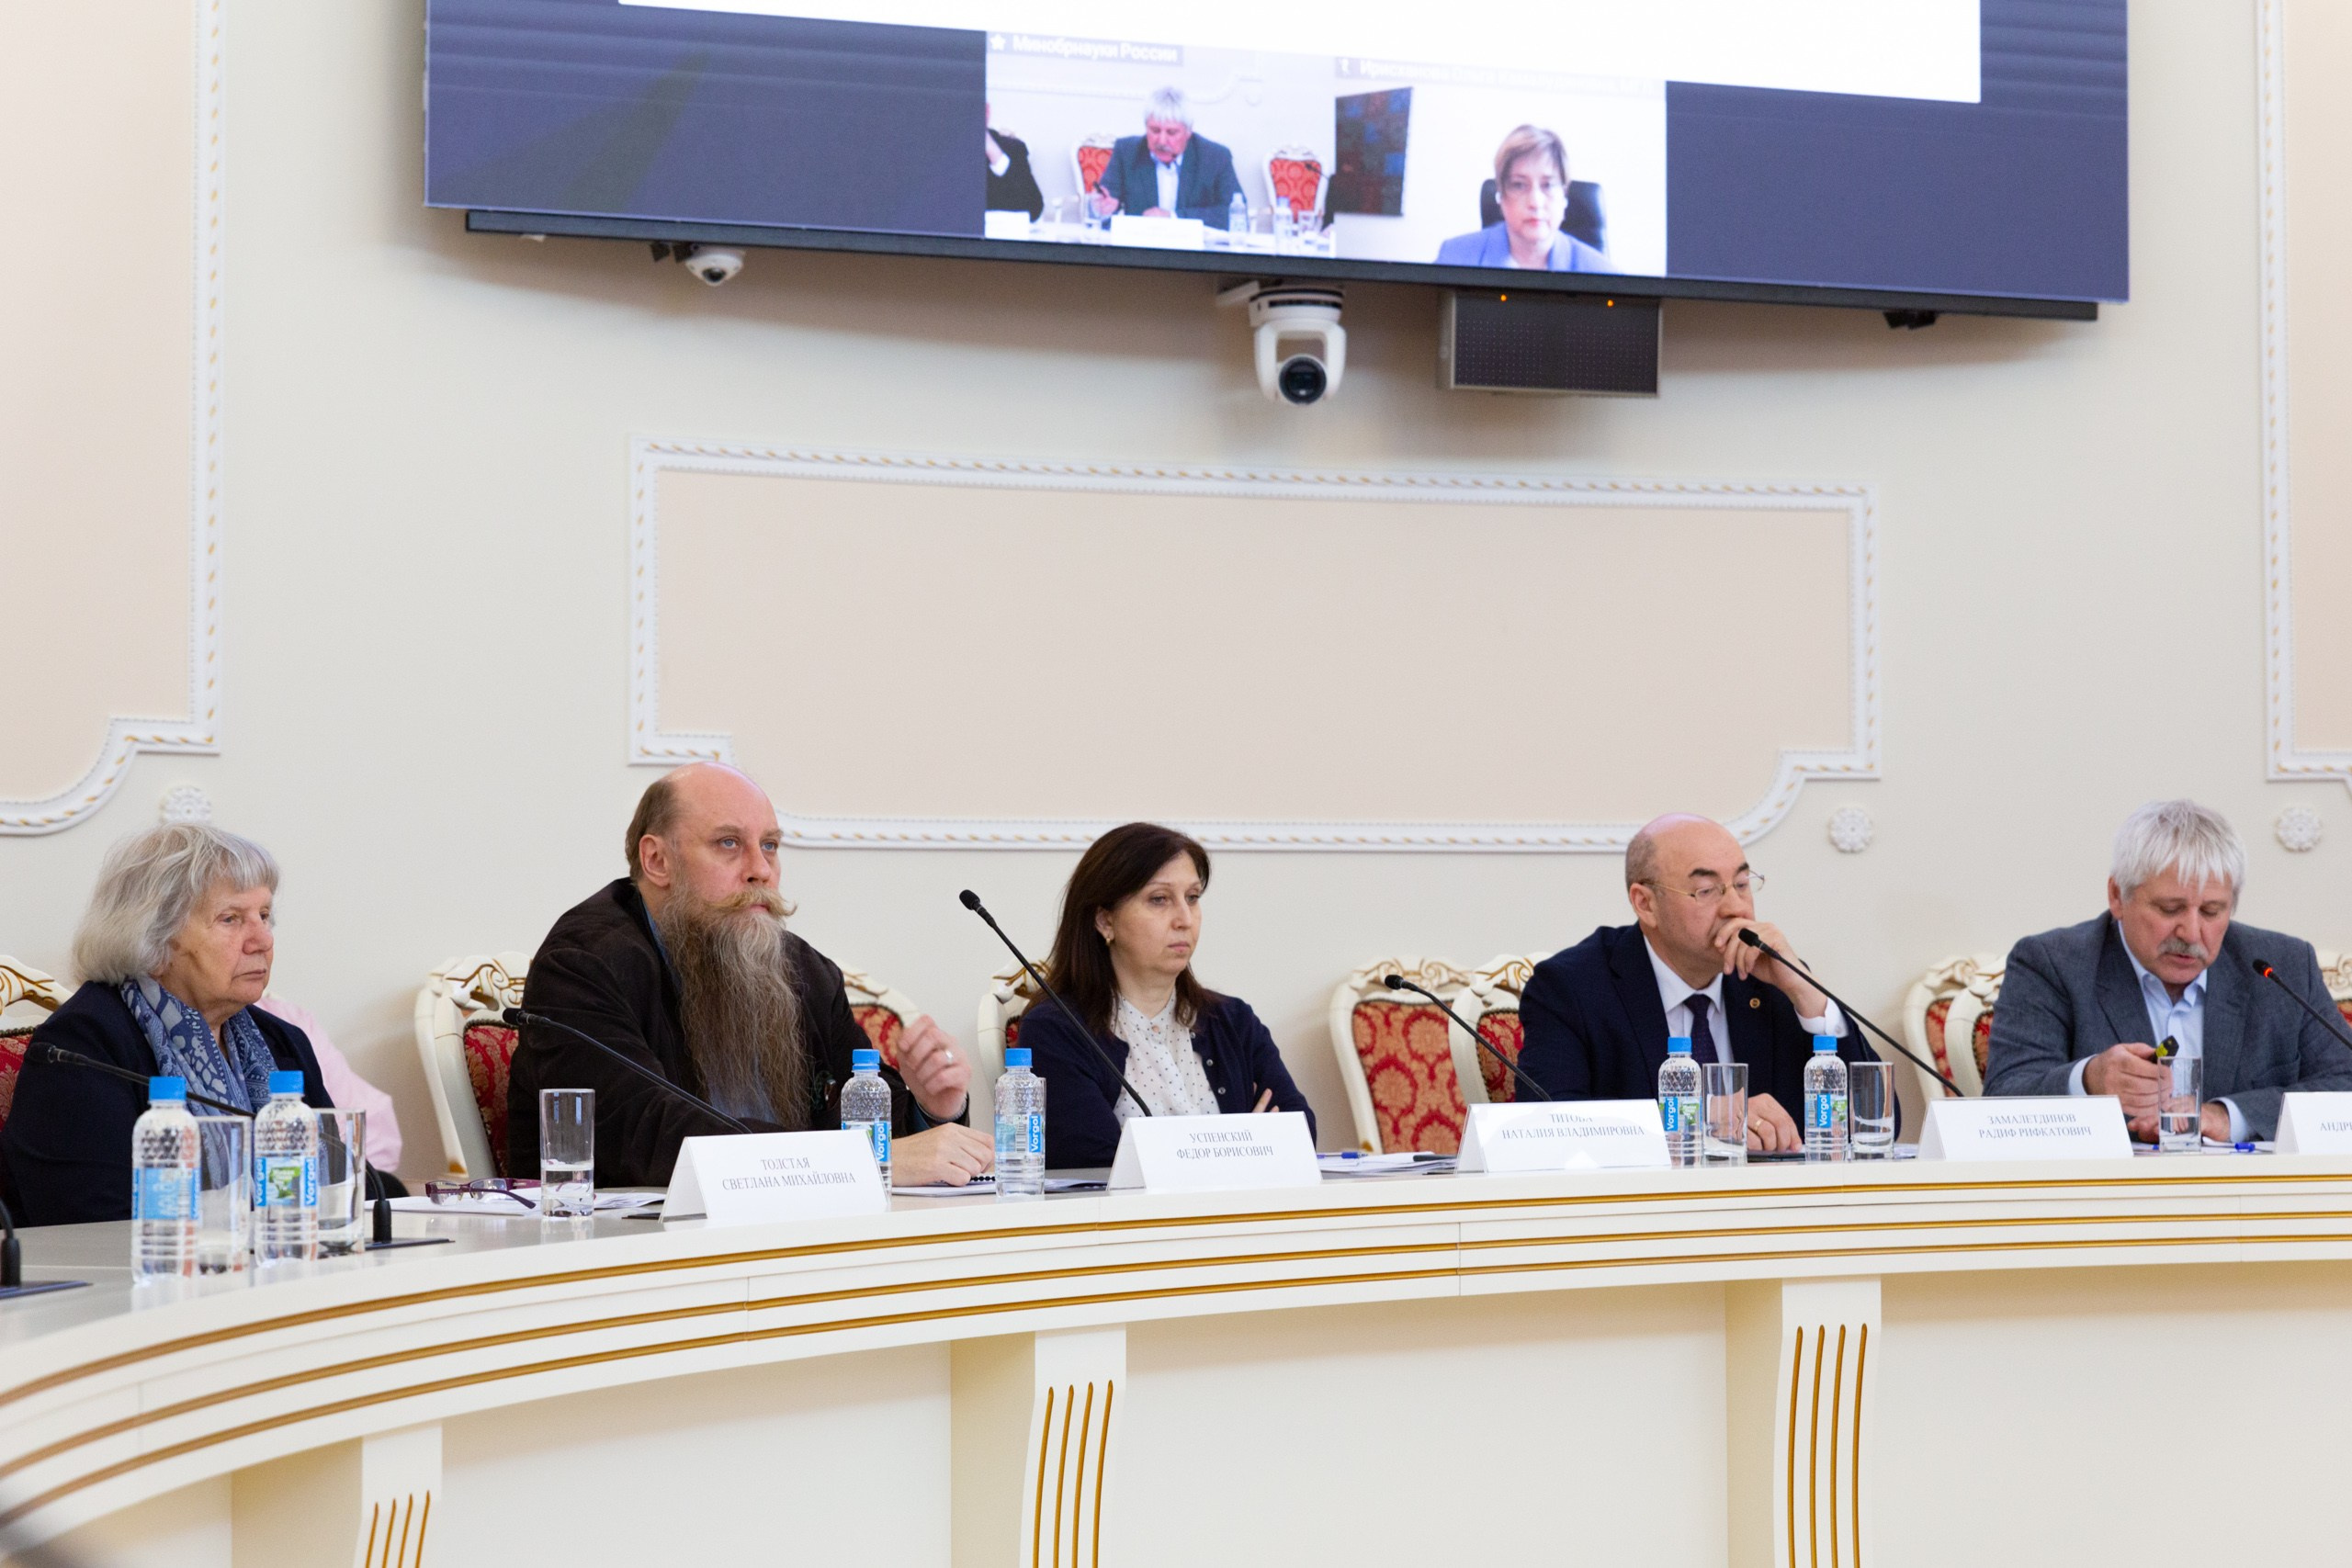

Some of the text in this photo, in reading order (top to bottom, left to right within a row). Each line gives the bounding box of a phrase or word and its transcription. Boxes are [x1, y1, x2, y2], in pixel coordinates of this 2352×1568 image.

[1012, 34, 1178, 62] Минобрнауки России
[1667, 1097, 1677, 1130] Vorgol
[1819, 1094, 1829, 1126] Vorgol
[1987, 1112, 2076, 1125] ЗАМАЛЕТДИНОВ
[1031, 1115, 1039, 1152] Vorgol
[1502, 1125, 1645, 1140] НАТАЛИЯ ВЛАДИМИРОВНА
[1978, 1126, 2092, 1140] РАДИФ РИФКАТОВИЧ
[2320, 1121, 2352, 1133] АНДР
[876, 1122, 887, 1160] Vorgol
[1189, 1129, 1253, 1144] УСПЕНСКИЙ
[1176, 1145, 1274, 1160] ФЕДОР БОРИСОВИЧ
[760, 1156, 810, 1171] ТОЛСТАЯ
[306, 1158, 316, 1205] Vorgol
[722, 1170, 856, 1190] СВЕТЛАНА МИХАЙЛОВНА
